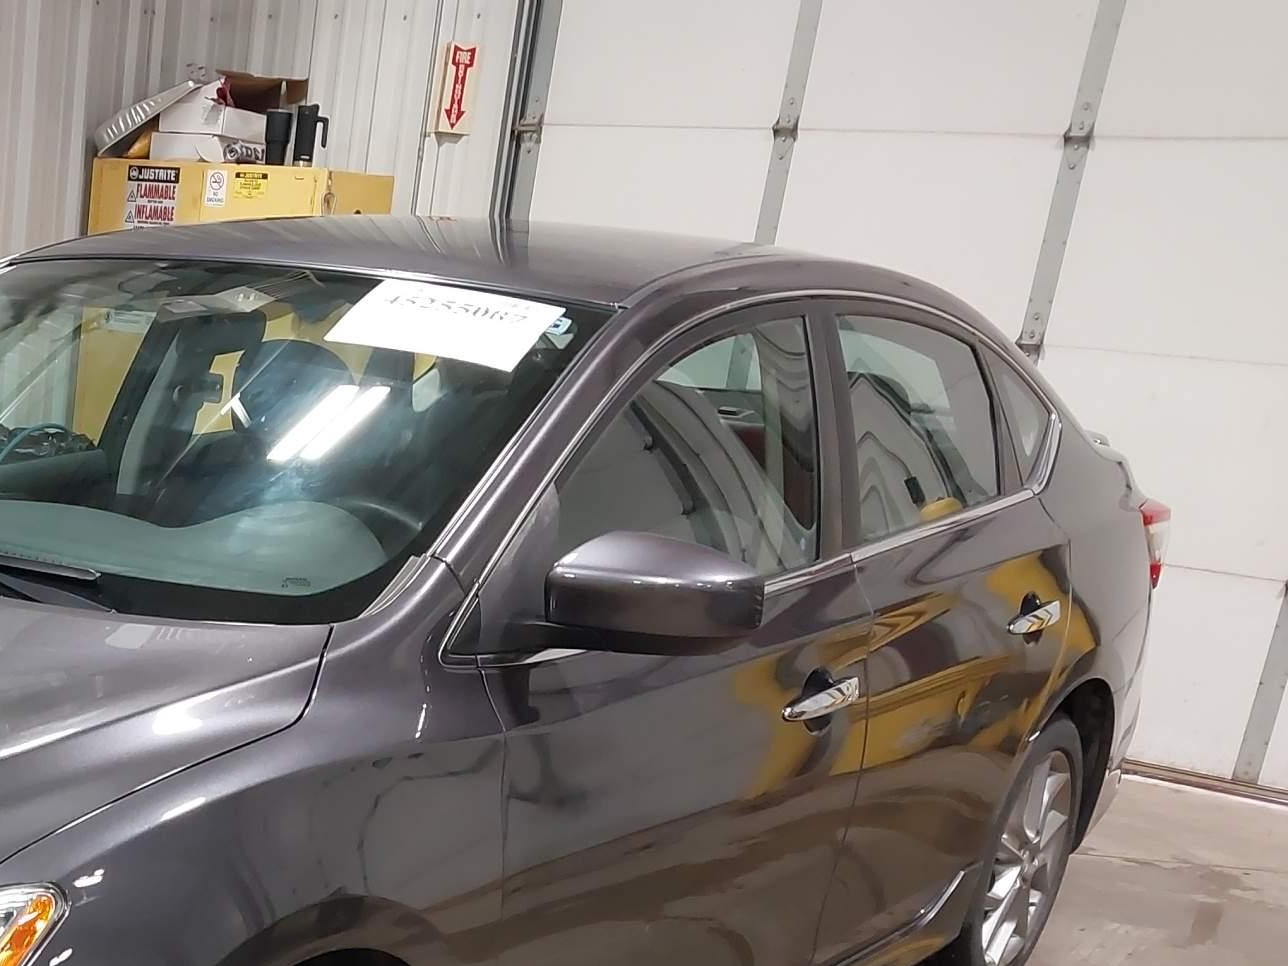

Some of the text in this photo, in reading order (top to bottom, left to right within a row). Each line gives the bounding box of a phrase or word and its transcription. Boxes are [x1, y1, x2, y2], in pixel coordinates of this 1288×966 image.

[455, 51, 472, 64] FIRE
[136, 183, 177, 201] FLAMMABLE
[134, 204, 174, 222] INFLAMABLE
